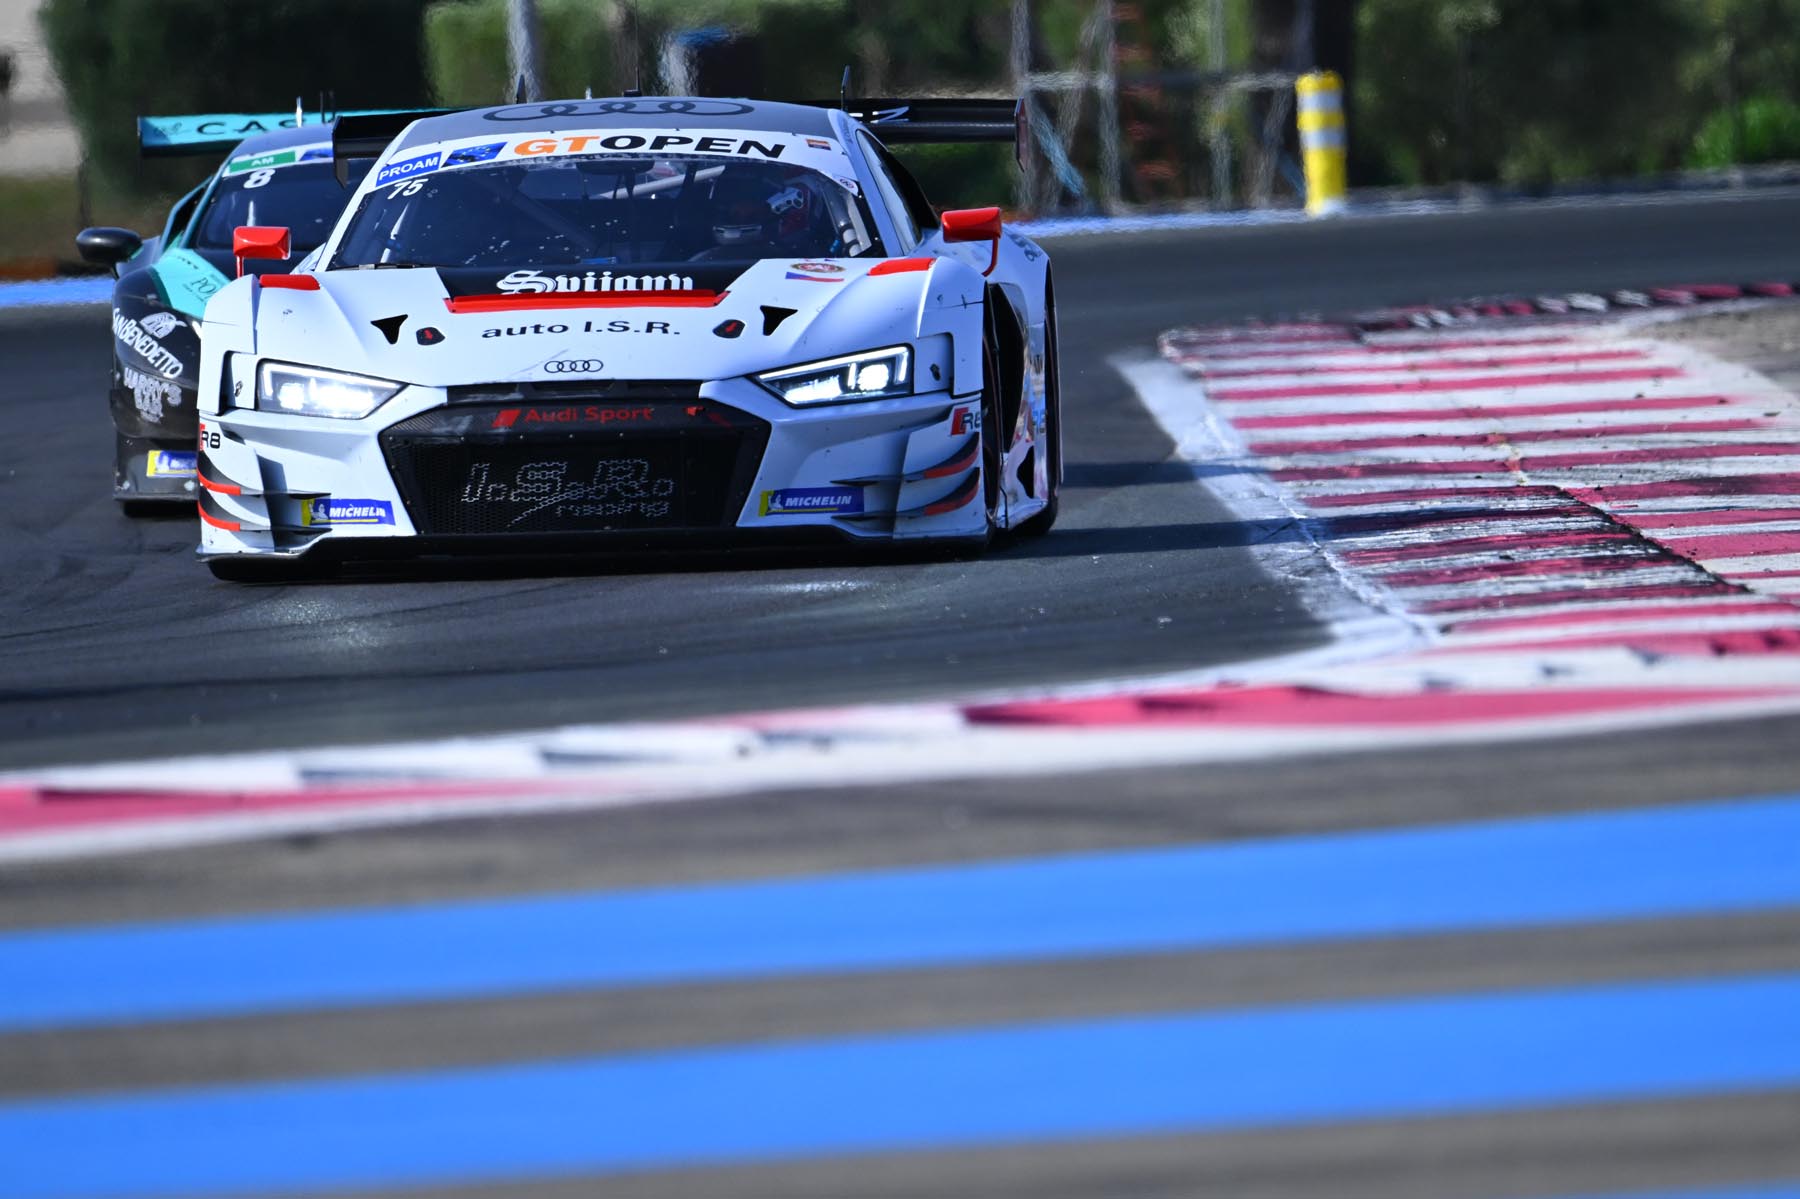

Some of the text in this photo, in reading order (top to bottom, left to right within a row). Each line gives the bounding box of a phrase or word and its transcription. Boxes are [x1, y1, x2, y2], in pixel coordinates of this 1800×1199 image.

[251, 156, 275, 168] AM
[379, 156, 439, 180] PROAM
[243, 168, 276, 189] 8
[387, 178, 429, 200] 75
[481, 320, 681, 338] auto I.S.R.
[524, 406, 654, 424] Audi Sport
[784, 495, 852, 507] MICHELIN
[329, 506, 386, 518] MICHELIN
